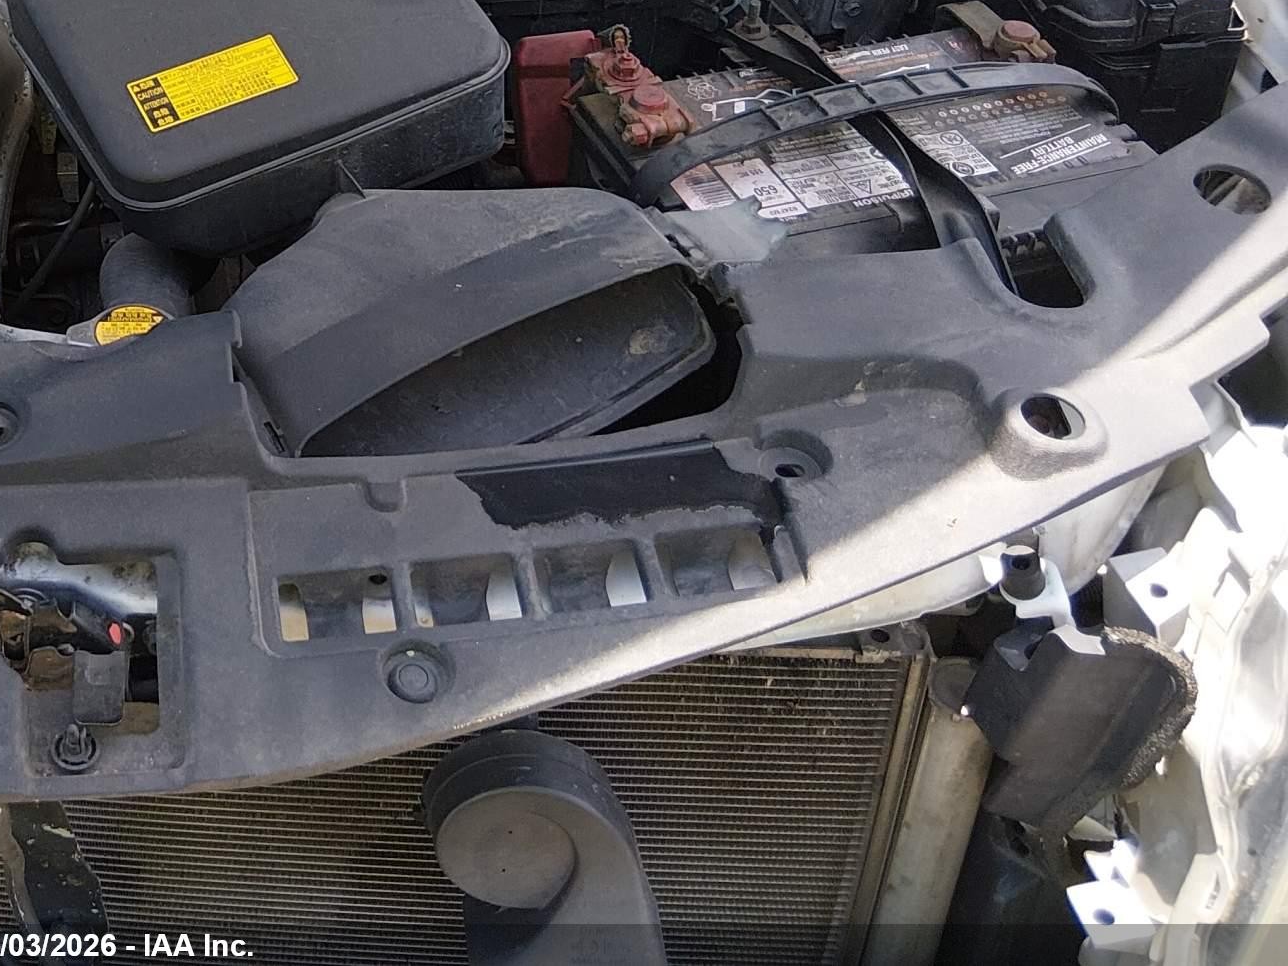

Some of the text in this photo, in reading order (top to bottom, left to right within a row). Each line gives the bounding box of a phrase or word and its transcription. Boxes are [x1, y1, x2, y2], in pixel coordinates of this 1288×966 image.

[137, 86, 164, 101] CAUTION
[1010, 133, 1108, 175] MAINTENANCE-FREE
[1030, 136, 1075, 158] BATTERY
[753, 184, 778, 197] 650
